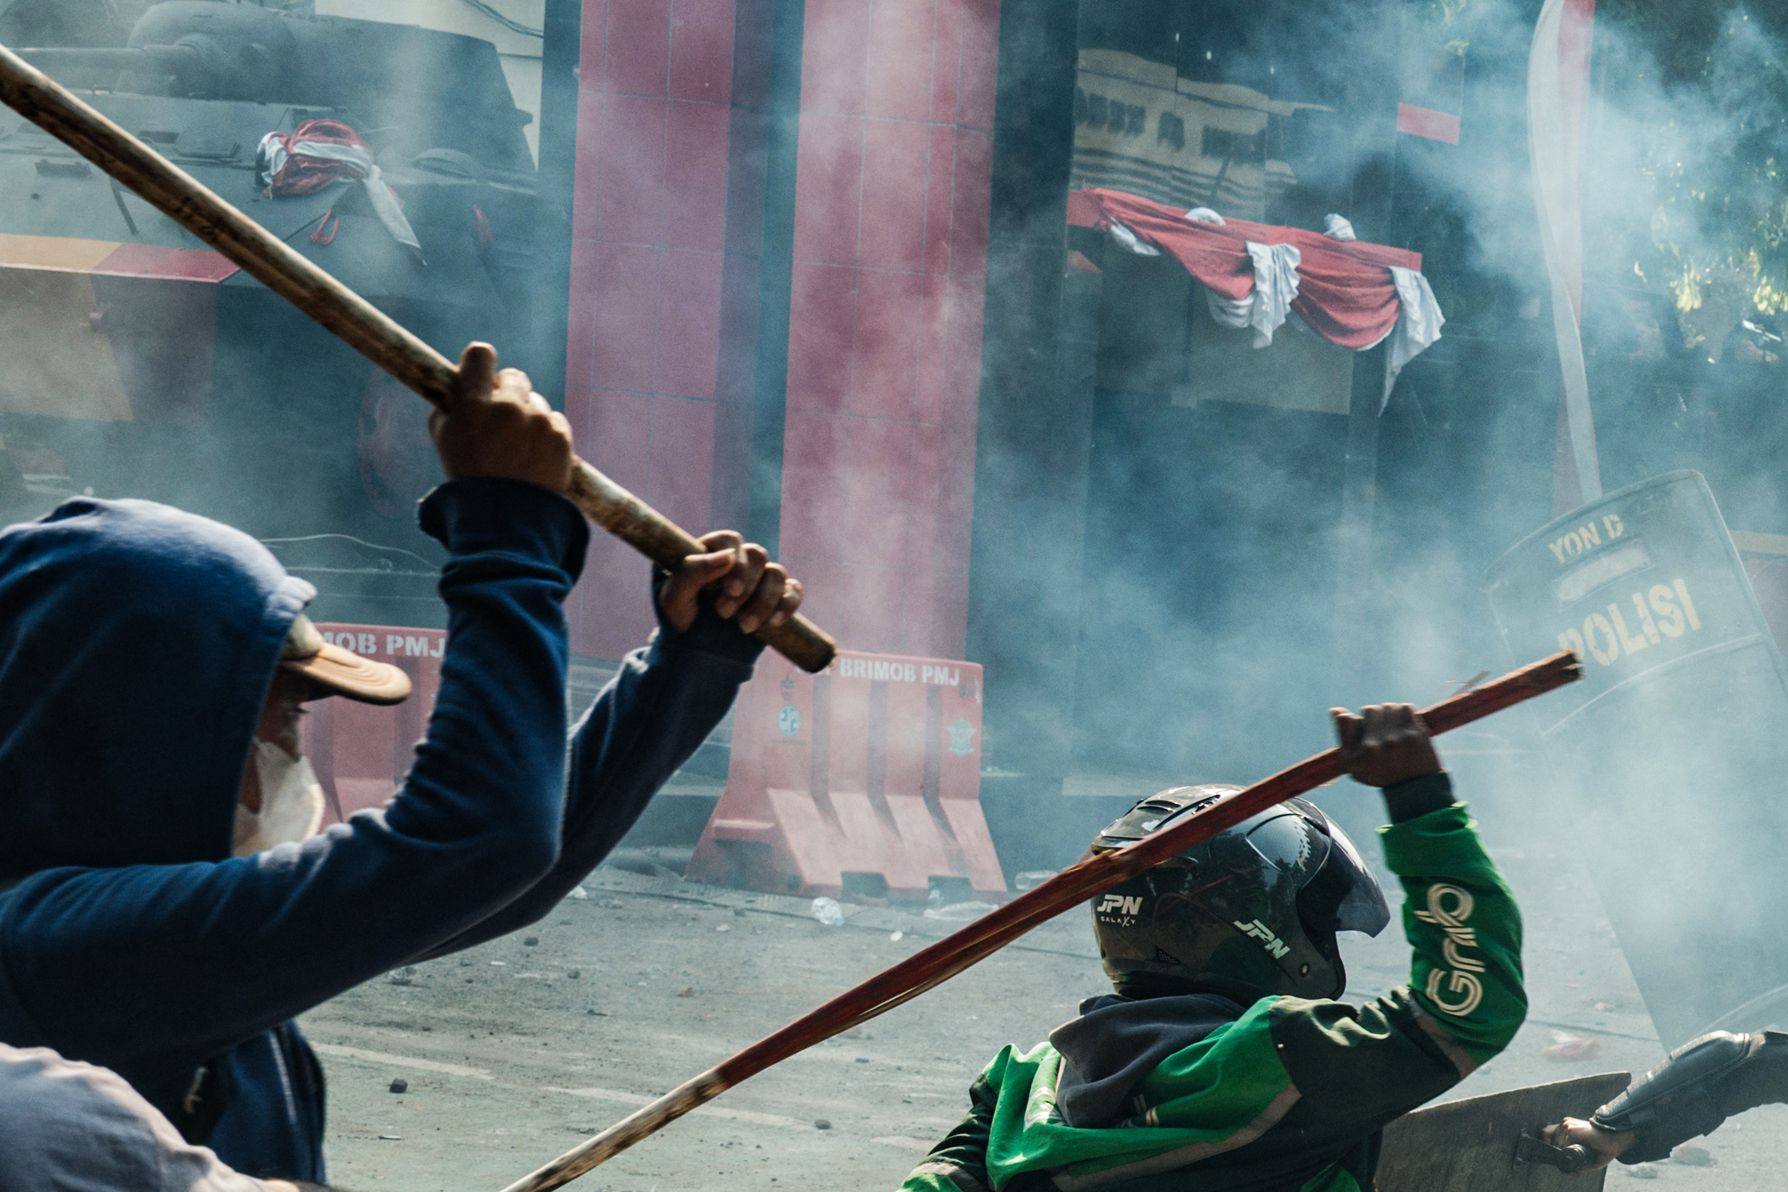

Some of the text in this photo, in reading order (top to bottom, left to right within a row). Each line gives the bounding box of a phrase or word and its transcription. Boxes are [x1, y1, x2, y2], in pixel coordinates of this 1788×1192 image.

[1548, 513, 1624, 564] YON D
[386, 634, 446, 658] PMJ
[839, 658, 917, 683] BRIMOB
[921, 665, 960, 686] PMJ
[1097, 894, 1143, 916] JPN
[1101, 916, 1136, 927] GALAXY
[1233, 919, 1290, 960] JPN
